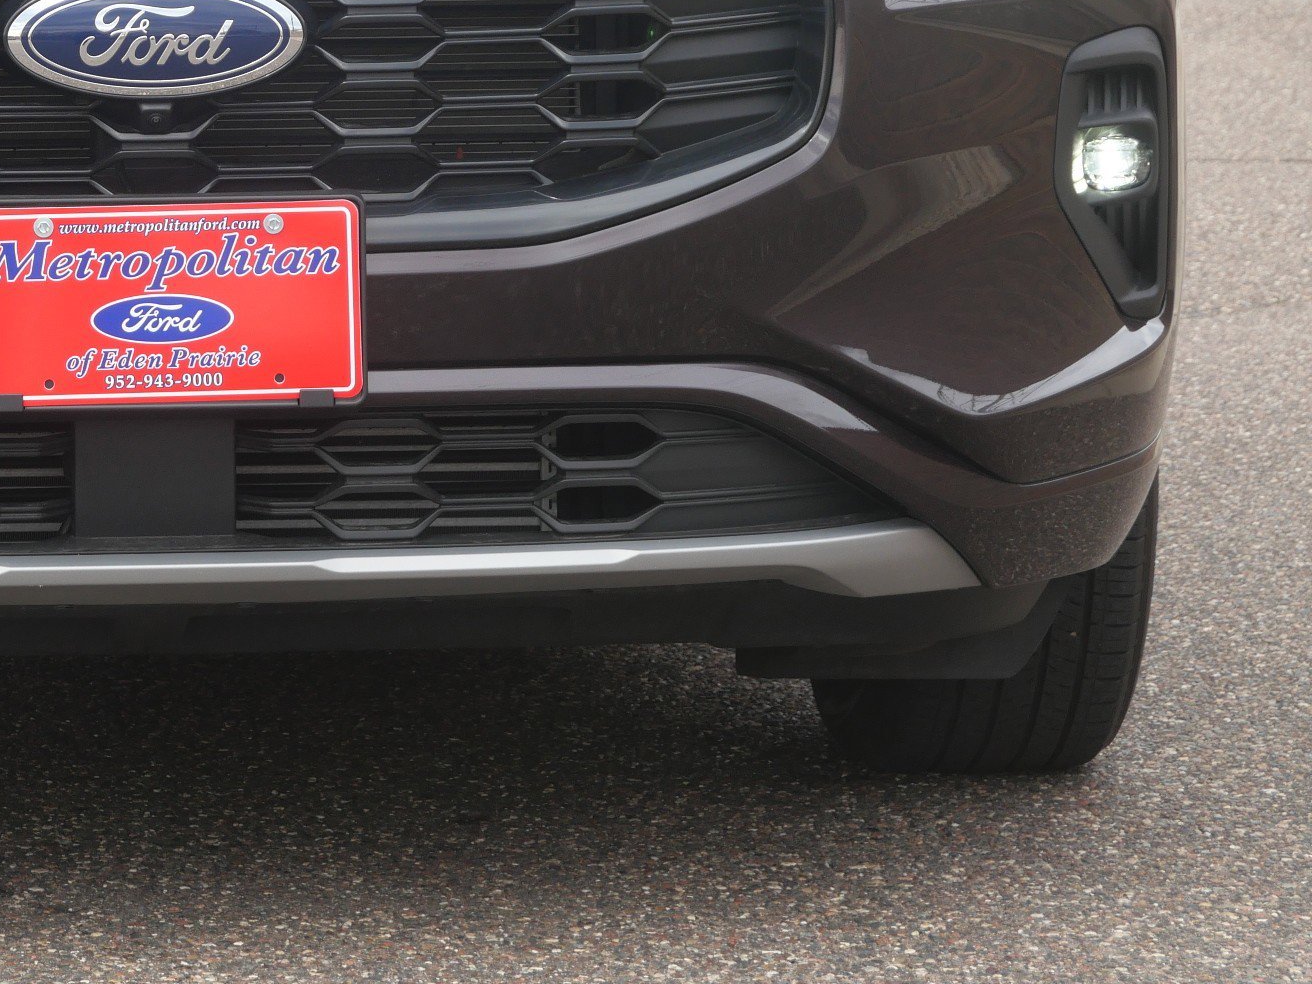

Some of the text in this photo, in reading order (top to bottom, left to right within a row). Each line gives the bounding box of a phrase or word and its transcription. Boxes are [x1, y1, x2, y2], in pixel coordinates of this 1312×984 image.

[79, 3, 234, 66] Ford
[58, 216, 261, 236] www.metropolitanford.com
[120, 302, 204, 333] Ford
[66, 344, 262, 378] of Eden Prairie
[104, 372, 224, 390] 952-943-9000
